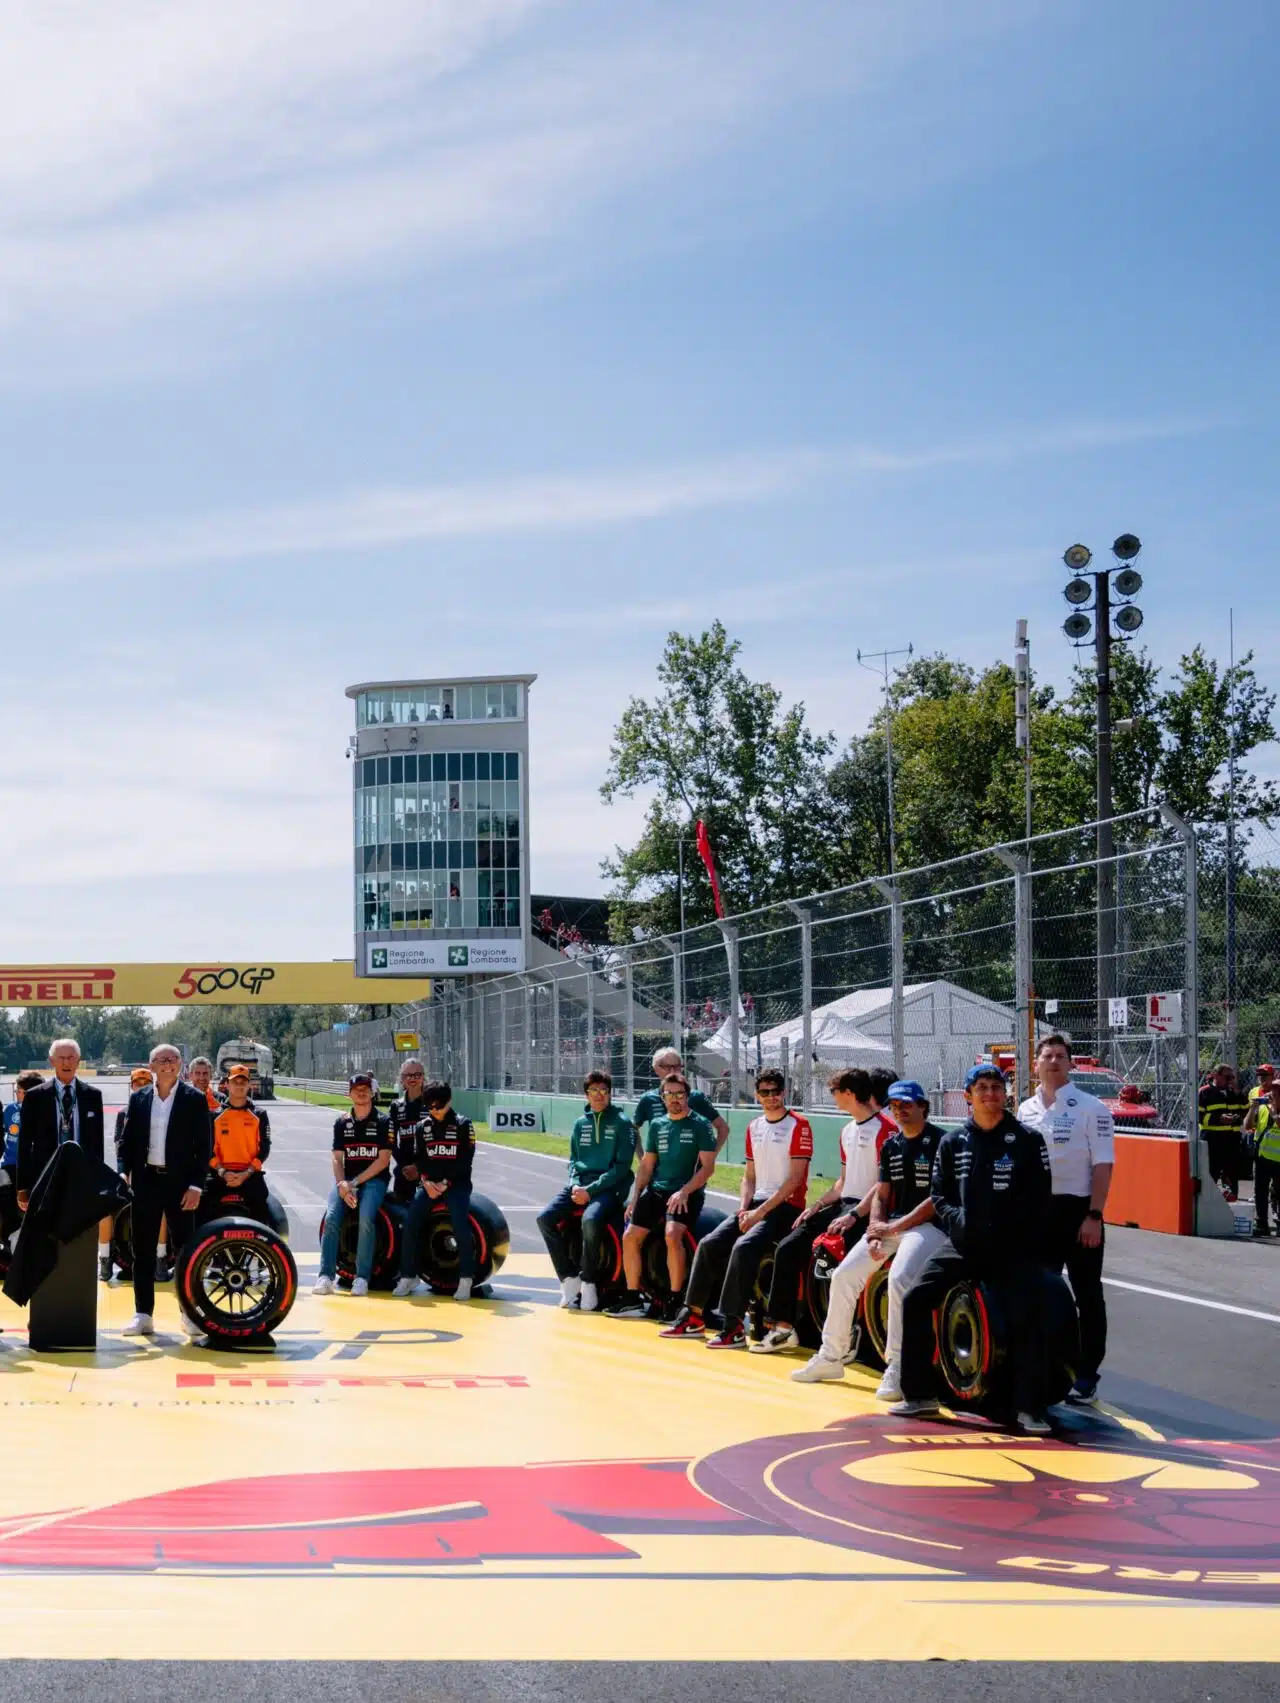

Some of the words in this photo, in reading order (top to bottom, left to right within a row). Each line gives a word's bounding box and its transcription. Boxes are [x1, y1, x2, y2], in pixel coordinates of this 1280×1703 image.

[389, 950, 425, 958] Regione
[471, 948, 507, 957] Regione
[389, 957, 435, 965] Lombardia
[471, 955, 517, 964] Lombardia
[496, 1112, 536, 1127] DRS
[360, 1146, 378, 1157] Bull
[438, 1144, 457, 1156] Bull
